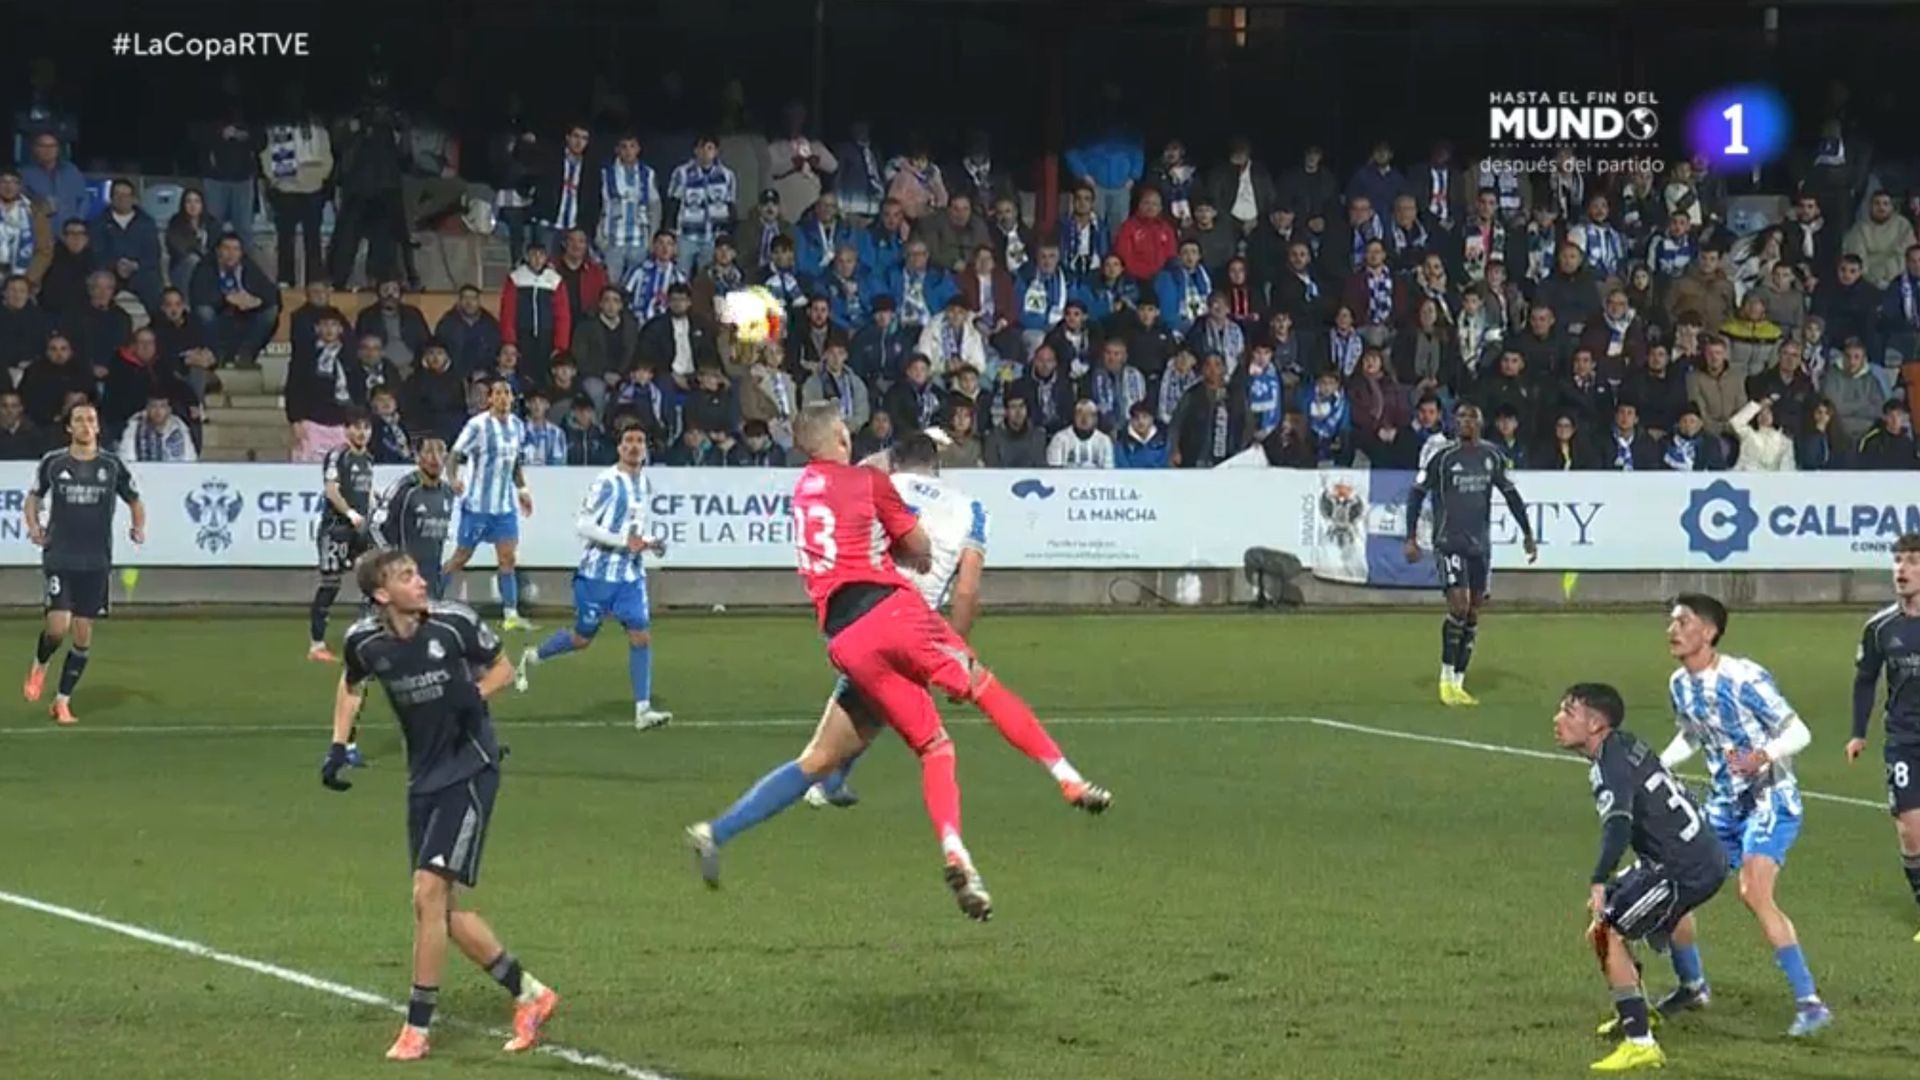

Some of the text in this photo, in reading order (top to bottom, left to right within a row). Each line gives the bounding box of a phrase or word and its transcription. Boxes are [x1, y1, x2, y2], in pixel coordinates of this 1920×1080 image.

[258, 492, 292, 512] CF
[651, 494, 685, 516] CF
[1068, 508, 1158, 521] LA MANCHA
[258, 519, 296, 540] DE
[651, 522, 797, 543] DE LA REI
[1644, 770, 1701, 842] 3
